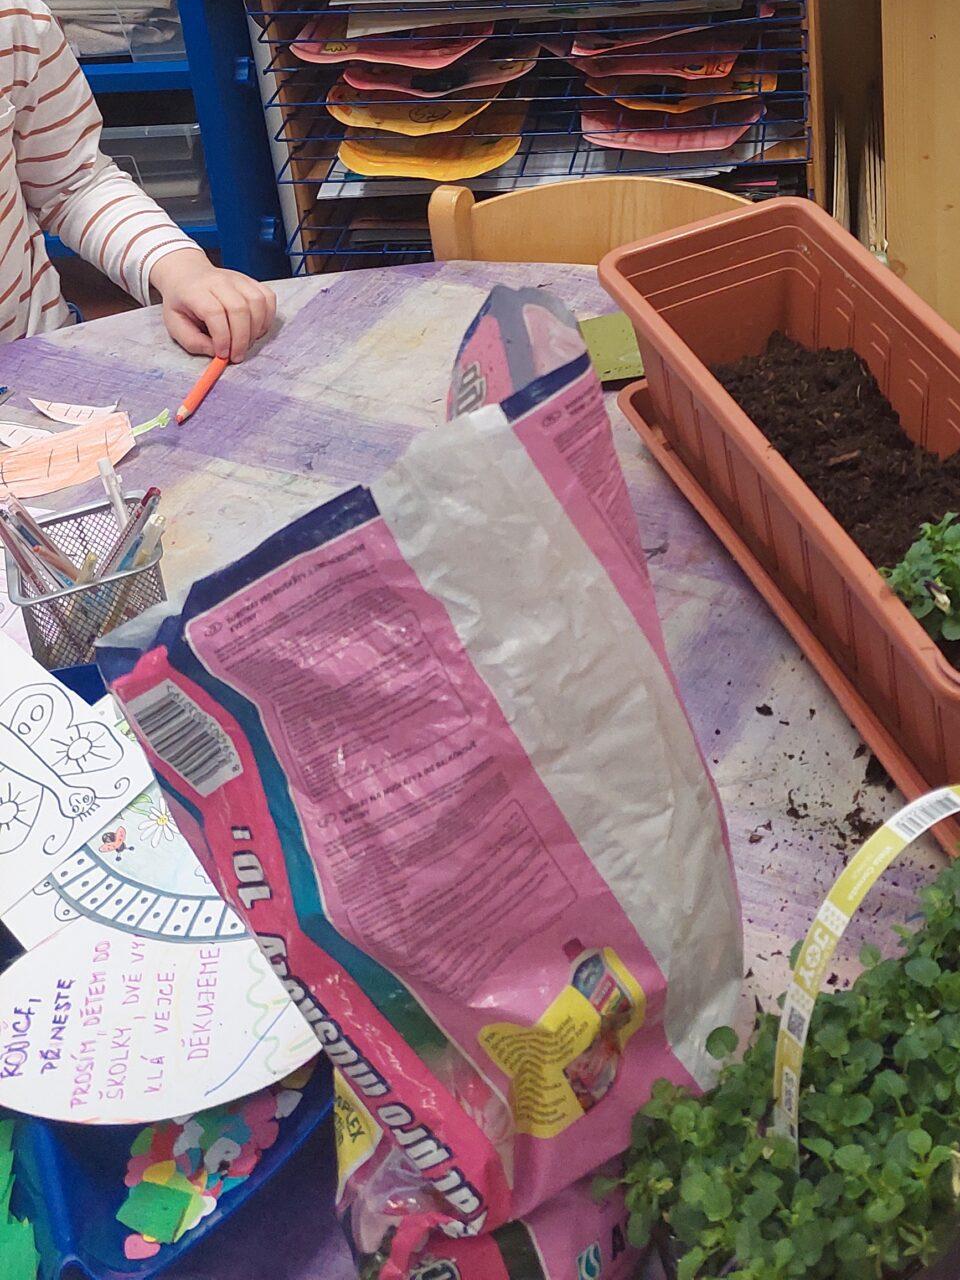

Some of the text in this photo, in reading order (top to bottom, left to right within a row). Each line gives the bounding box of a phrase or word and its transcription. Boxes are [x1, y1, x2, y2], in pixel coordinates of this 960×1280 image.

[232, 850, 272, 910] 10
[92, 939, 111, 963] DO
[121, 972, 143, 1006] DVĚ
[377, 1101, 453, 1173] pro
